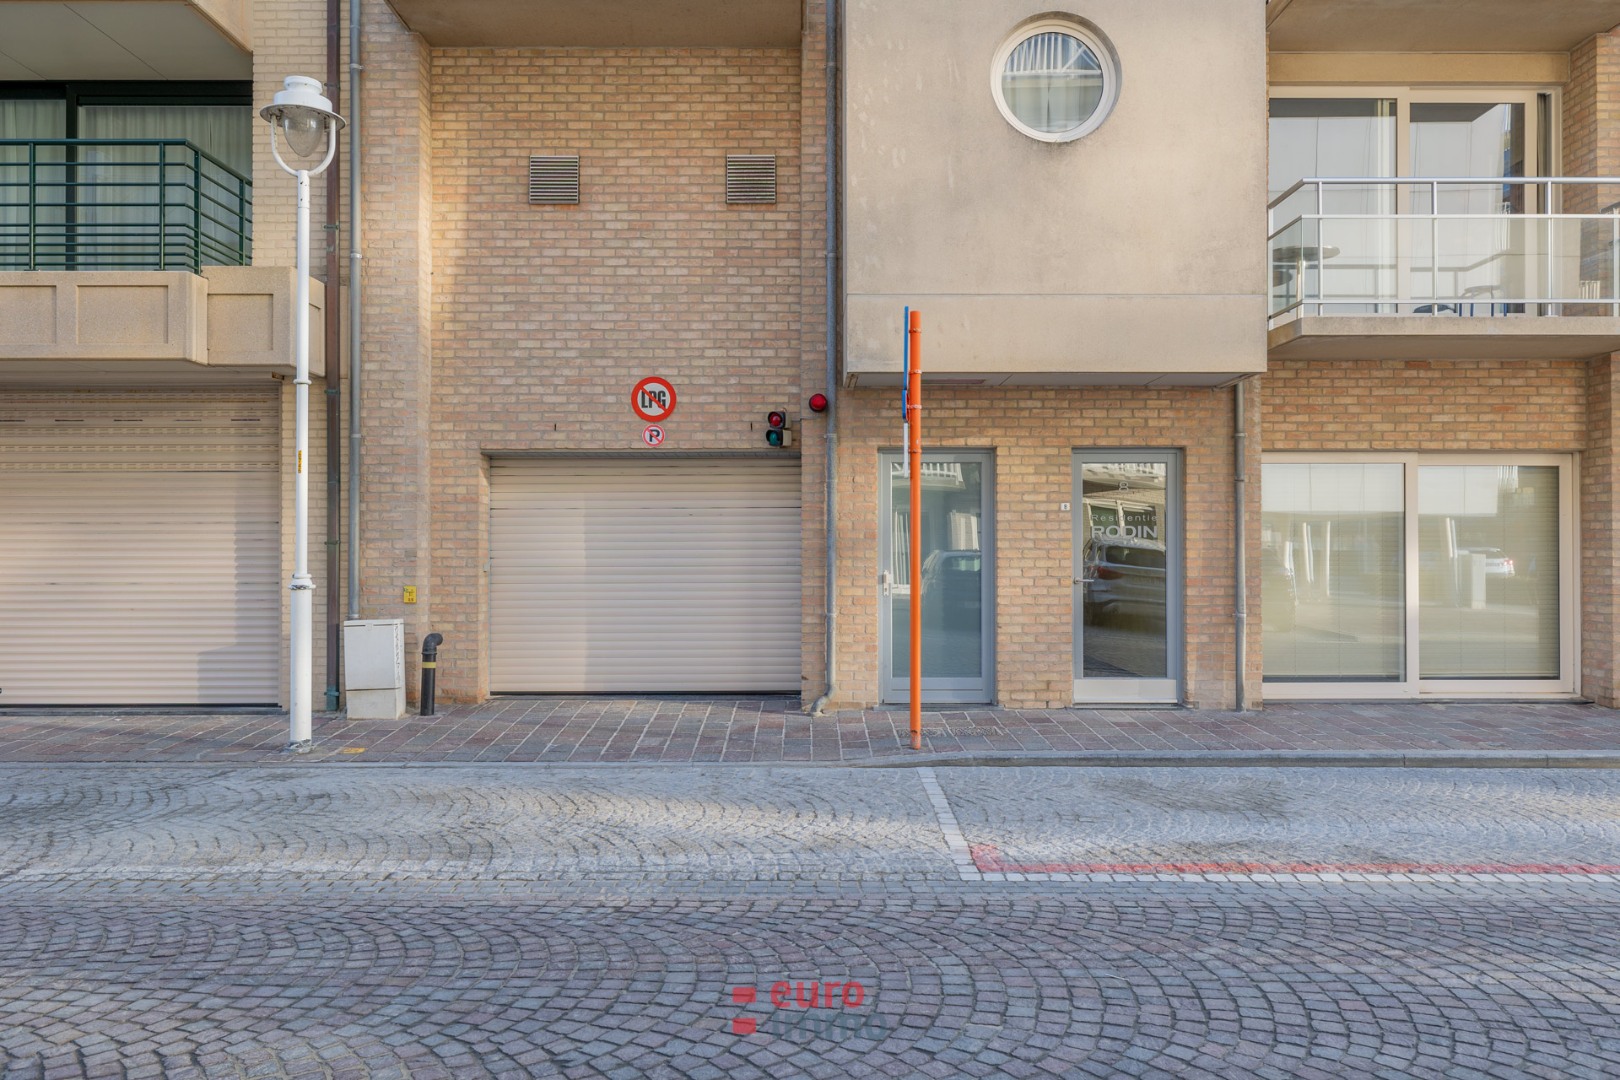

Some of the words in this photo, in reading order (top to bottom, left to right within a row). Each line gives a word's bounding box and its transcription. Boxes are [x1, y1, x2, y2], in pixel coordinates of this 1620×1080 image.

[641, 390, 667, 409] LPG
[649, 429, 661, 442] P
[1118, 481, 1129, 493] 8
[1091, 514, 1158, 522] Residentie
[1091, 525, 1158, 539] RODIN
